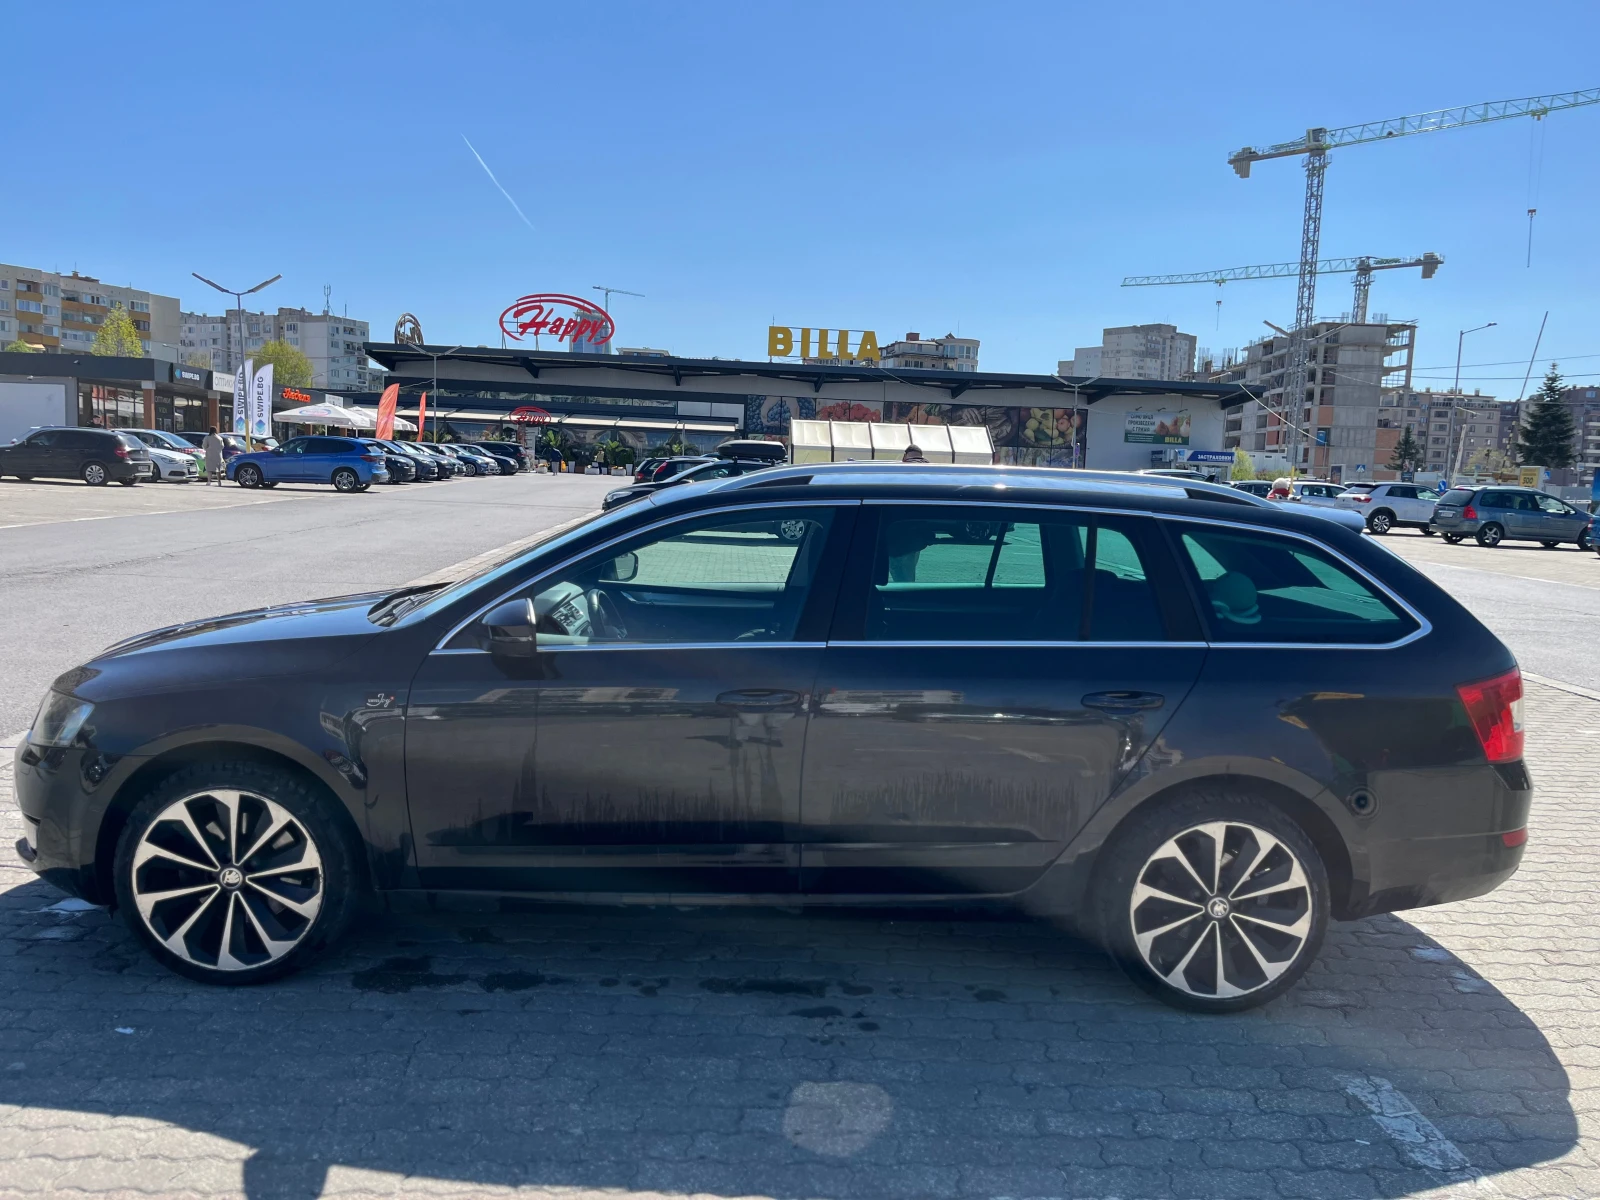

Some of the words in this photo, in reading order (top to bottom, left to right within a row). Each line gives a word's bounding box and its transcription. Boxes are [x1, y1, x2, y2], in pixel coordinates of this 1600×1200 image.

[513, 305, 604, 342] Happy
[768, 326, 880, 361] BILLA
[182, 371, 200, 381] SWIPE.BG
